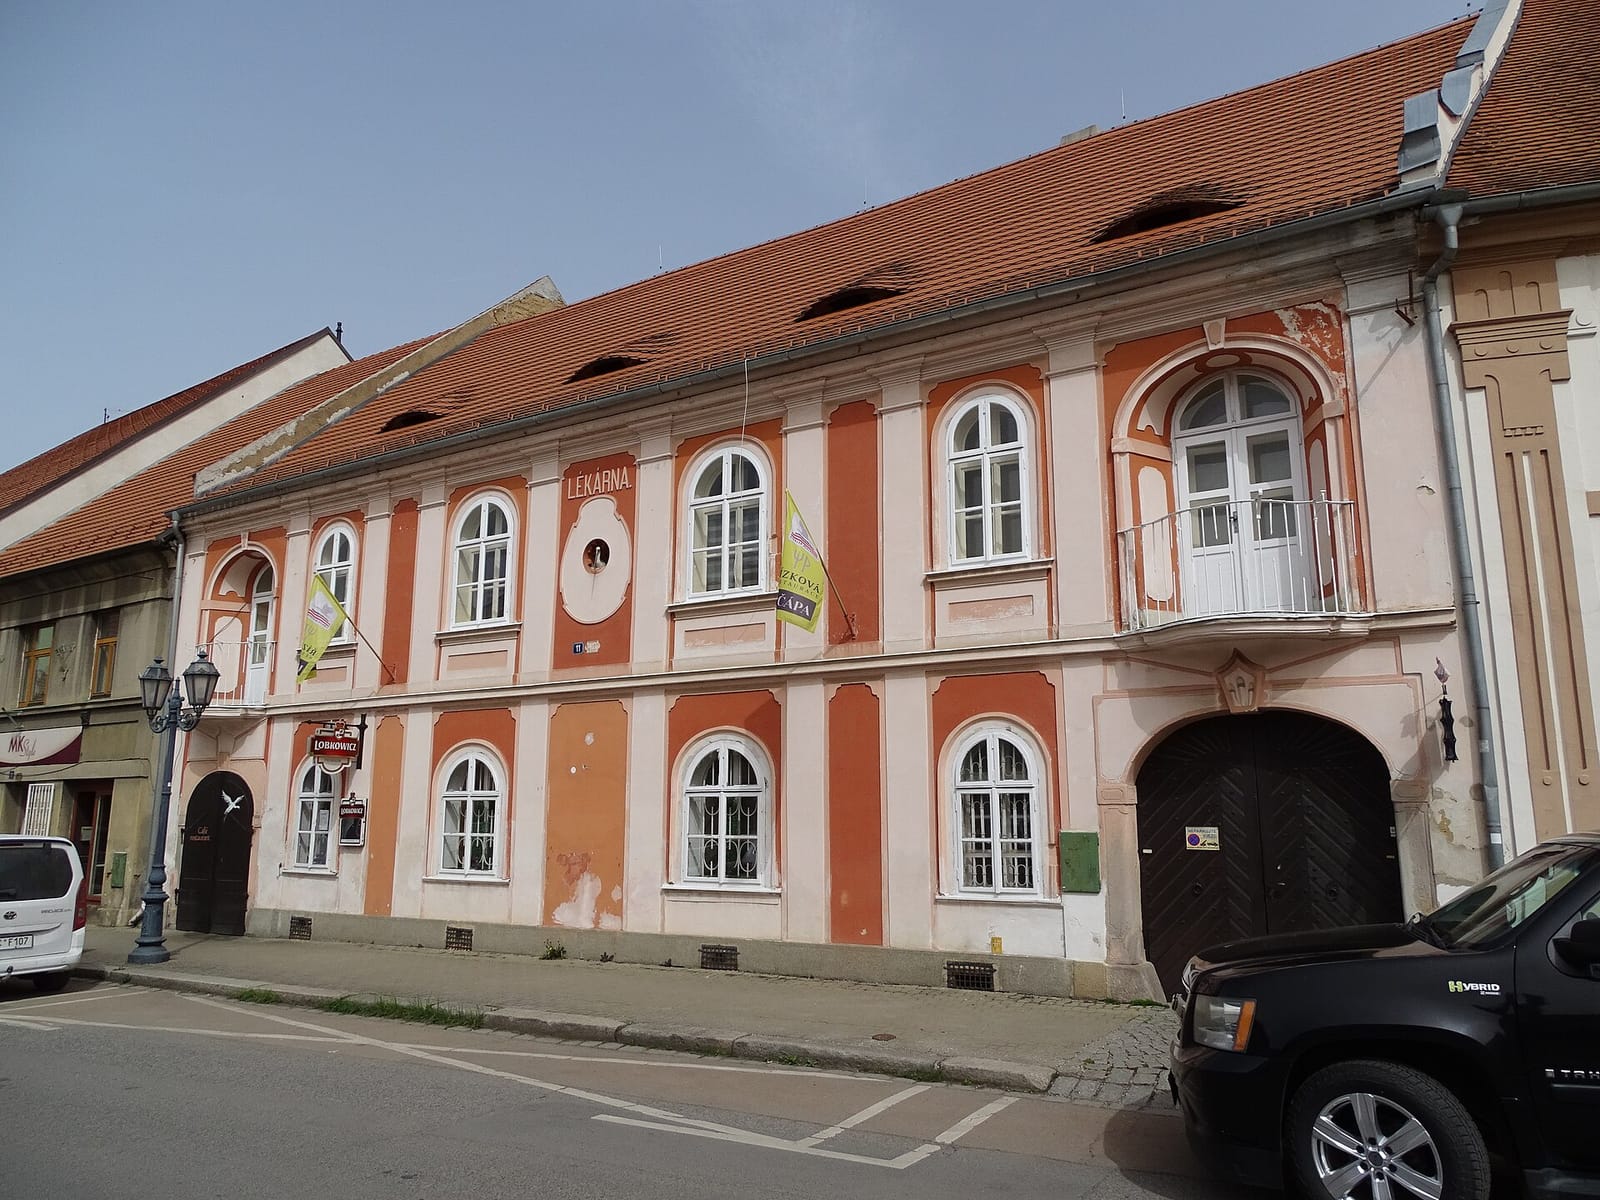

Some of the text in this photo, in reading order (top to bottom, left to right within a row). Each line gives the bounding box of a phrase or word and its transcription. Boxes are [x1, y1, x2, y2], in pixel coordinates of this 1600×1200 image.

[777, 593, 810, 617] ČÁPA
[314, 740, 357, 752] LOBKOWICZ
[1448, 980, 1501, 993] HYBRID
